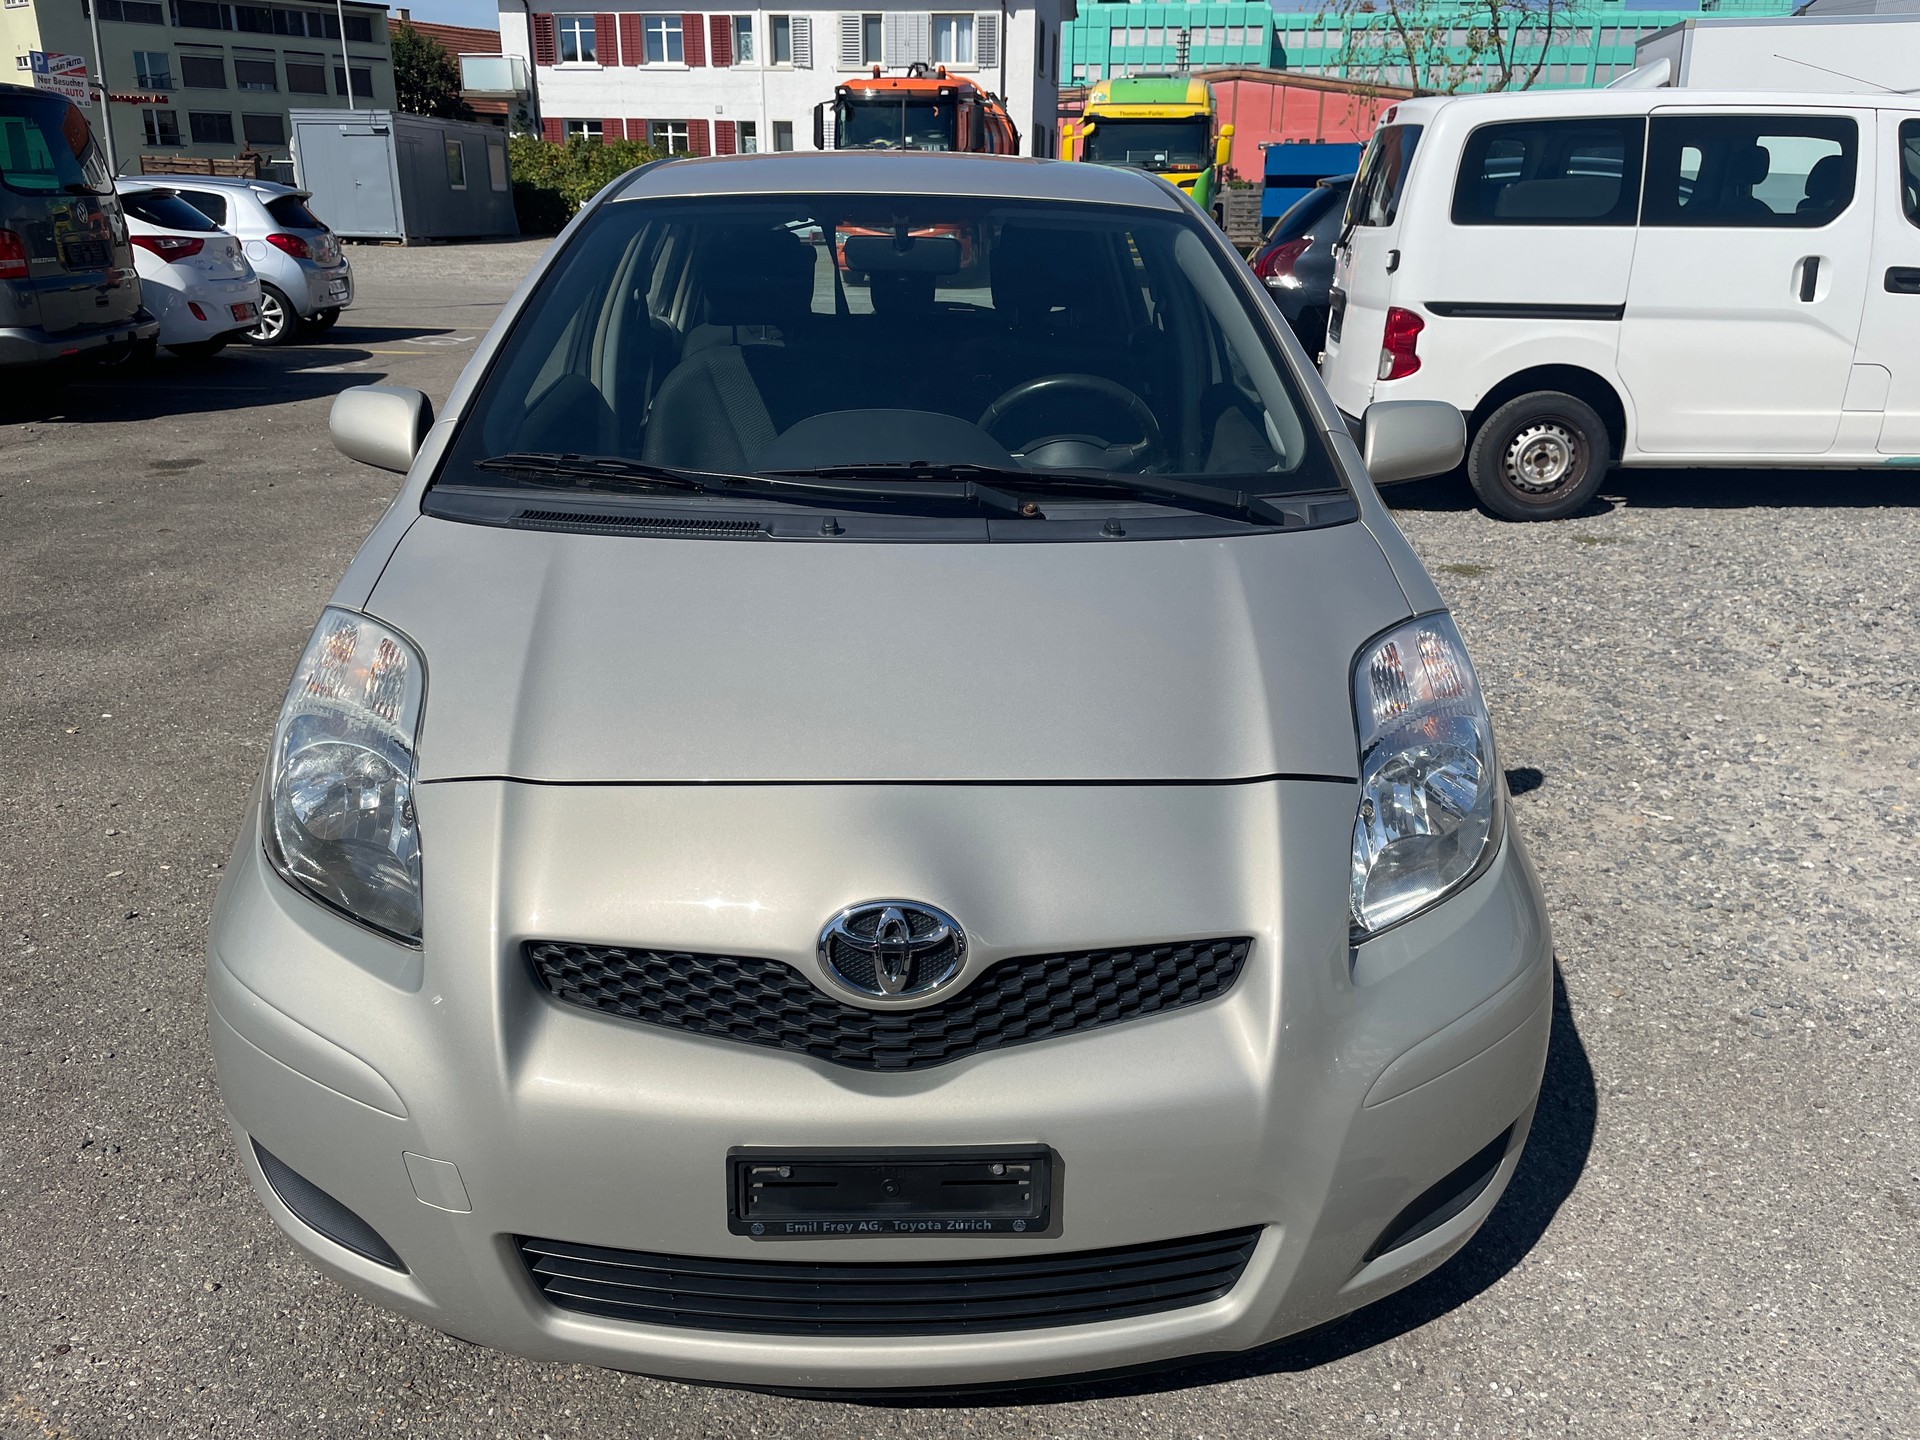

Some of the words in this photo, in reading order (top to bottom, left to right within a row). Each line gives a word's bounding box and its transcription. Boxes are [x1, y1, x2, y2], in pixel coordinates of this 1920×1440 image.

[33, 52, 43, 71] P
[37, 75, 51, 84] Nur
[53, 77, 84, 87] Besucher
[786, 1222, 817, 1233] Emil
[822, 1222, 853, 1234] Frey
[893, 1220, 942, 1233] Toyota
[946, 1219, 992, 1231] Zürich
